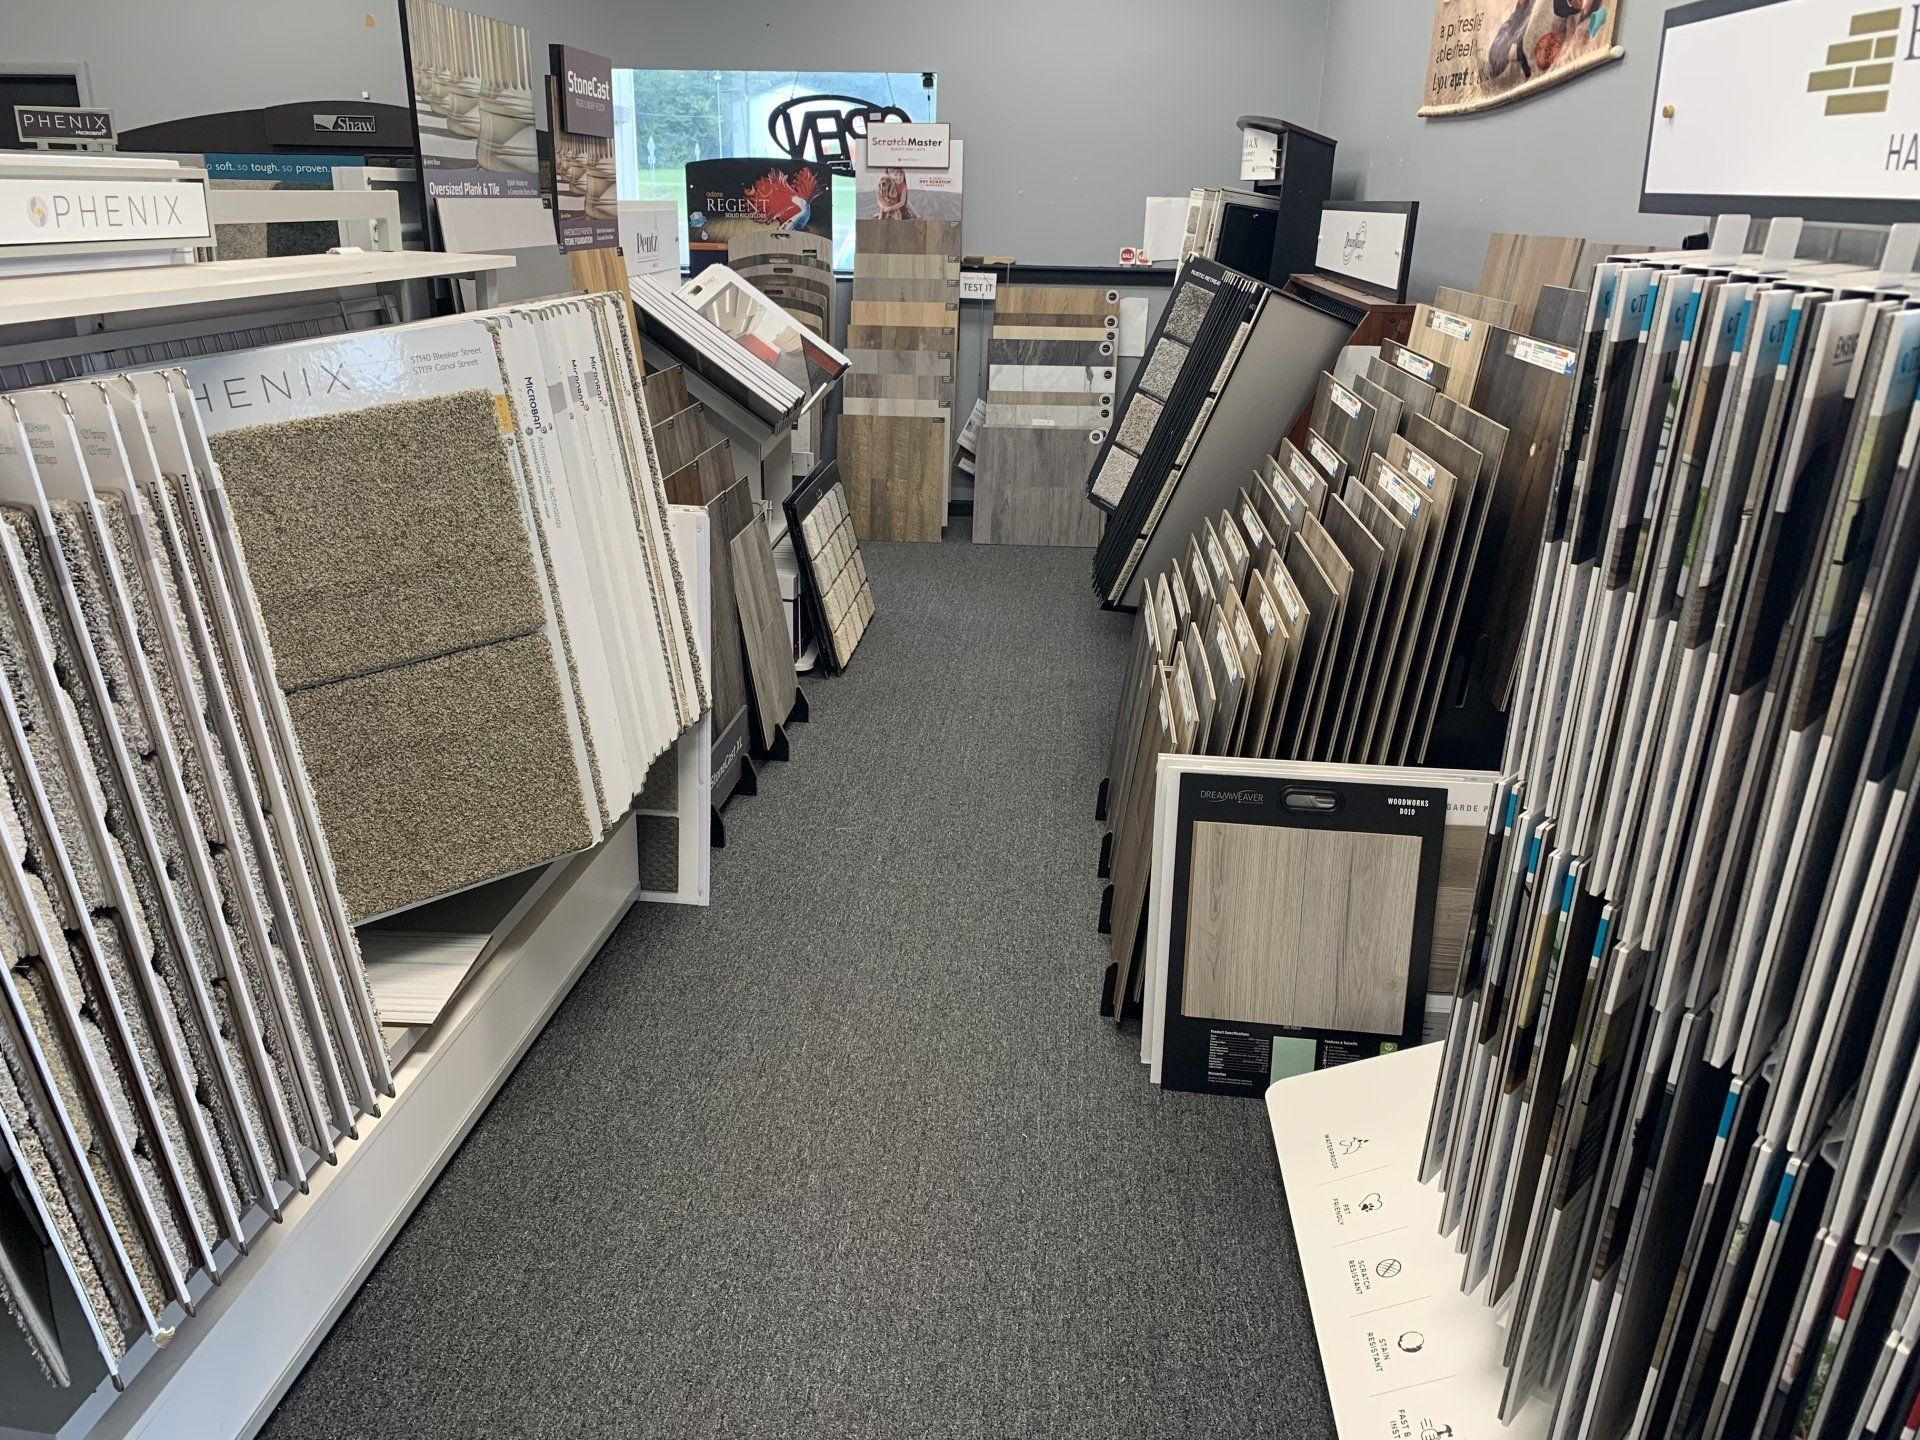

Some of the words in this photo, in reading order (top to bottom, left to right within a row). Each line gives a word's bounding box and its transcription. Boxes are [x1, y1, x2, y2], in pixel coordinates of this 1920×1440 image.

[567, 70, 610, 101] StoneCast
[23, 113, 106, 129] PHENIX
[337, 117, 374, 131] Shaw
[872, 136, 944, 147] ScratchMaster
[215, 161, 236, 171] soft.
[237, 163, 248, 171] so
[250, 162, 280, 174] tough.
[282, 164, 293, 172] so
[296, 165, 331, 174] proven.
[429, 182, 464, 196] Oversized
[464, 182, 482, 196] Plank
[482, 183, 489, 196] &
[489, 182, 500, 196] Tile
[52, 195, 183, 228] PHENIX
[707, 198, 770, 212] REGENT
[963, 282, 984, 292] TEST
[985, 283, 993, 292] IT
[410, 353, 432, 364] ST140
[432, 350, 460, 361] Bleeker
[460, 347, 482, 356] Street
[412, 364, 433, 376] ST139
[434, 361, 456, 372] Canal
[457, 358, 479, 369] Street
[195, 363, 351, 412] HENIX
[524, 376, 542, 429] MICROBAN
[537, 435, 553, 485] Antimicrobial
[547, 487, 562, 529] Technology
[1200, 789, 1264, 802] DREAMWEAVER
[1387, 797, 1429, 807] WOODWORKS
[1324, 1133, 1339, 1169] WATERPROOF
[1332, 1198, 1345, 1226] FRIENDLY
[1342, 1203, 1352, 1215] PET
[1348, 1259, 1364, 1295] RESISTANT
[1358, 1259, 1371, 1290] SCRATCH
[1367, 1331, 1384, 1373] RESISTANT
[1379, 1338, 1391, 1361] STAIN
[1398, 1409, 1410, 1429] FAST
